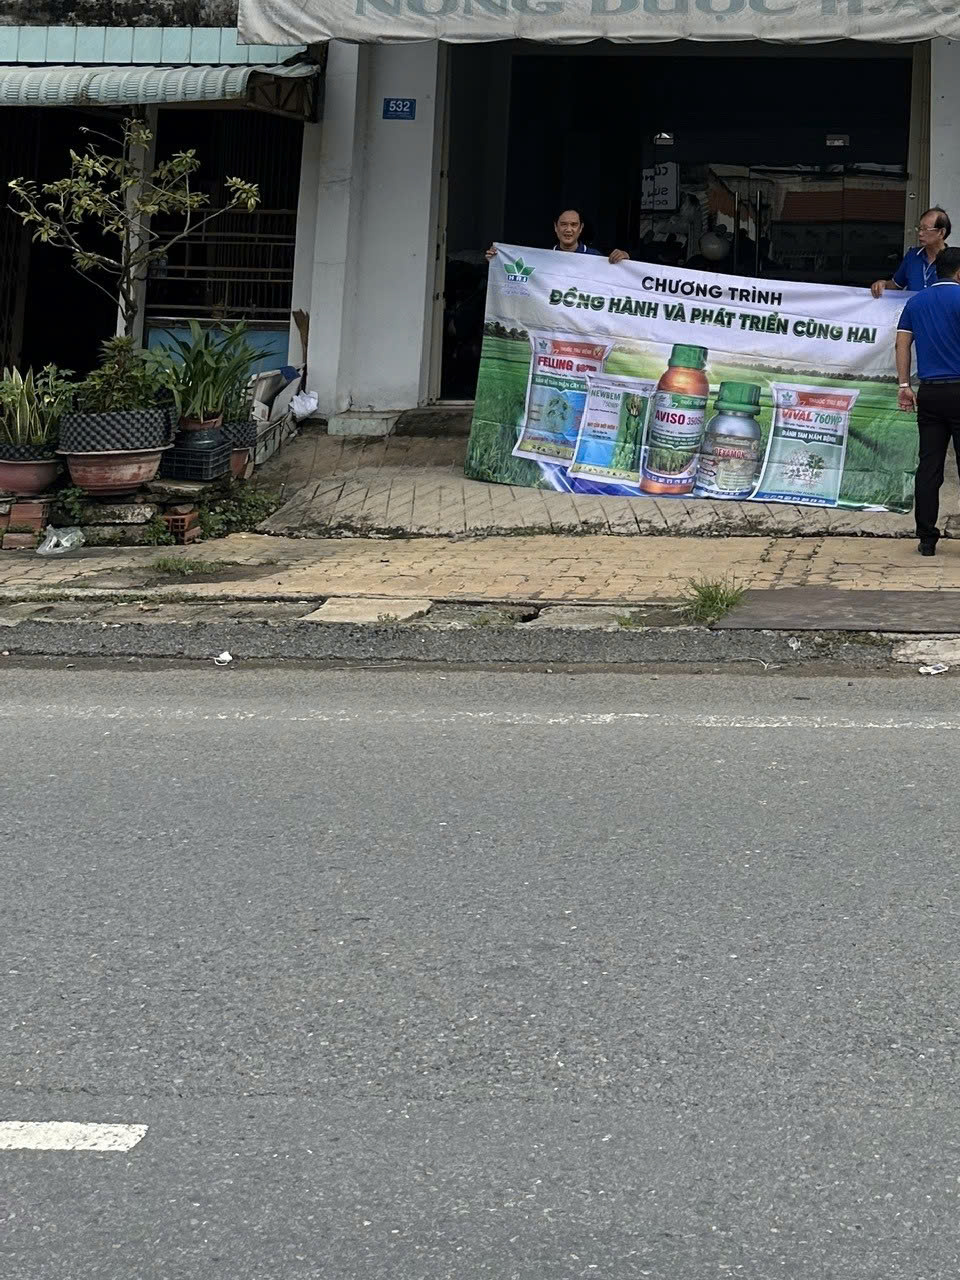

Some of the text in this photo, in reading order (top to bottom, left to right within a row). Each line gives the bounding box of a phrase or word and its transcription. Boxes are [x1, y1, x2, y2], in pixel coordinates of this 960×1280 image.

[389, 100, 410, 111] 532
[641, 276, 782, 306] CHƯƠNG TRÌNH
[549, 286, 604, 311] ĐỒNG
[608, 296, 659, 319] HÀNH
[663, 302, 686, 323] VÀ
[690, 307, 736, 328] PHÁT
[738, 311, 789, 335] TRIỂN
[793, 318, 843, 341] CÙNG
[847, 326, 877, 344] HAI
[538, 356, 573, 371] FELLING
[655, 409, 685, 425] AVISO
[781, 408, 843, 426] VIVAL 760WP
